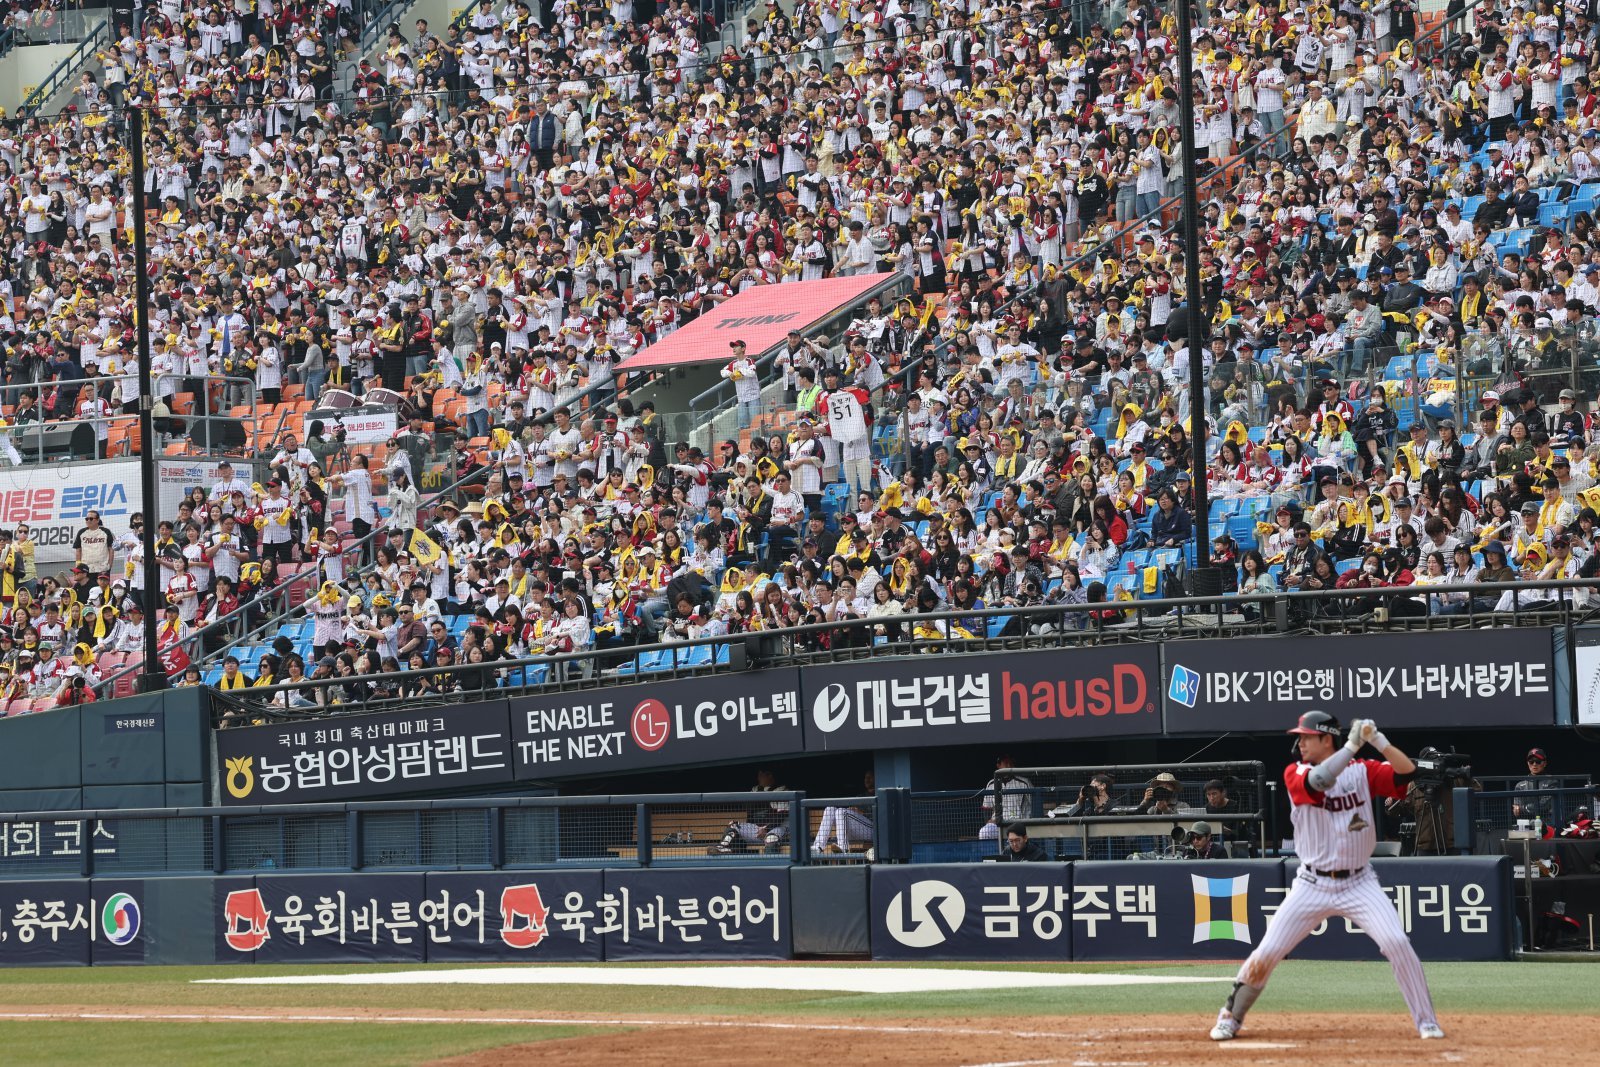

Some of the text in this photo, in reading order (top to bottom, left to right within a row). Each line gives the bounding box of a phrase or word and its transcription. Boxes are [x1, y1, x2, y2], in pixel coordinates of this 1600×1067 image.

[346, 234, 357, 245] 51
[715, 312, 800, 329] TVING
[833, 405, 852, 420] 51
[60, 484, 128, 519] 트윈스
[857, 672, 990, 730] 대보건설
[1002, 664, 1147, 721] hausD
[116, 718, 156, 728] 한국경제신문
[278, 718, 446, 748] 국내 최대 축산테마파크
[527, 702, 614, 734] ENABLE
[259, 733, 506, 794] 농협안성팜랜드
[518, 731, 626, 764] THE NEXT
[1312, 792, 1365, 812] EOUL
[275, 889, 485, 946] 육회바른연어
[554, 884, 780, 944] 육회바른연어
[982, 884, 1157, 940] 금강주택
